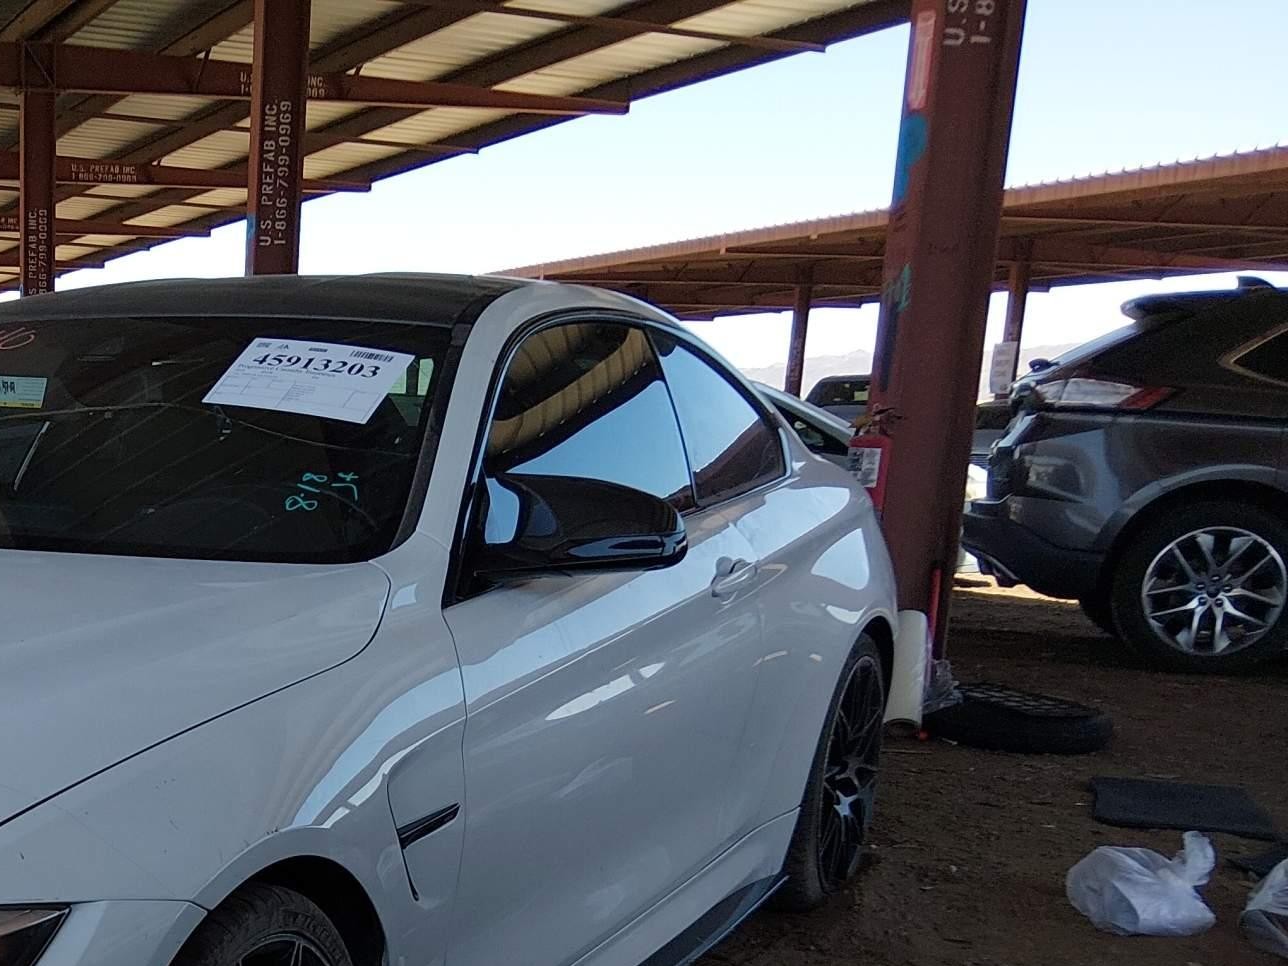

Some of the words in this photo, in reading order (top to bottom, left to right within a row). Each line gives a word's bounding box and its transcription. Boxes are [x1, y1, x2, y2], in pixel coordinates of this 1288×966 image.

[264, 99, 279, 132] INC.
[261, 139, 277, 206] PREFAB
[274, 100, 292, 246] 1-866-799-0969
[259, 215, 273, 247] U.S.
[28, 234, 38, 280] PREFAB
[252, 352, 381, 379] 45913203
